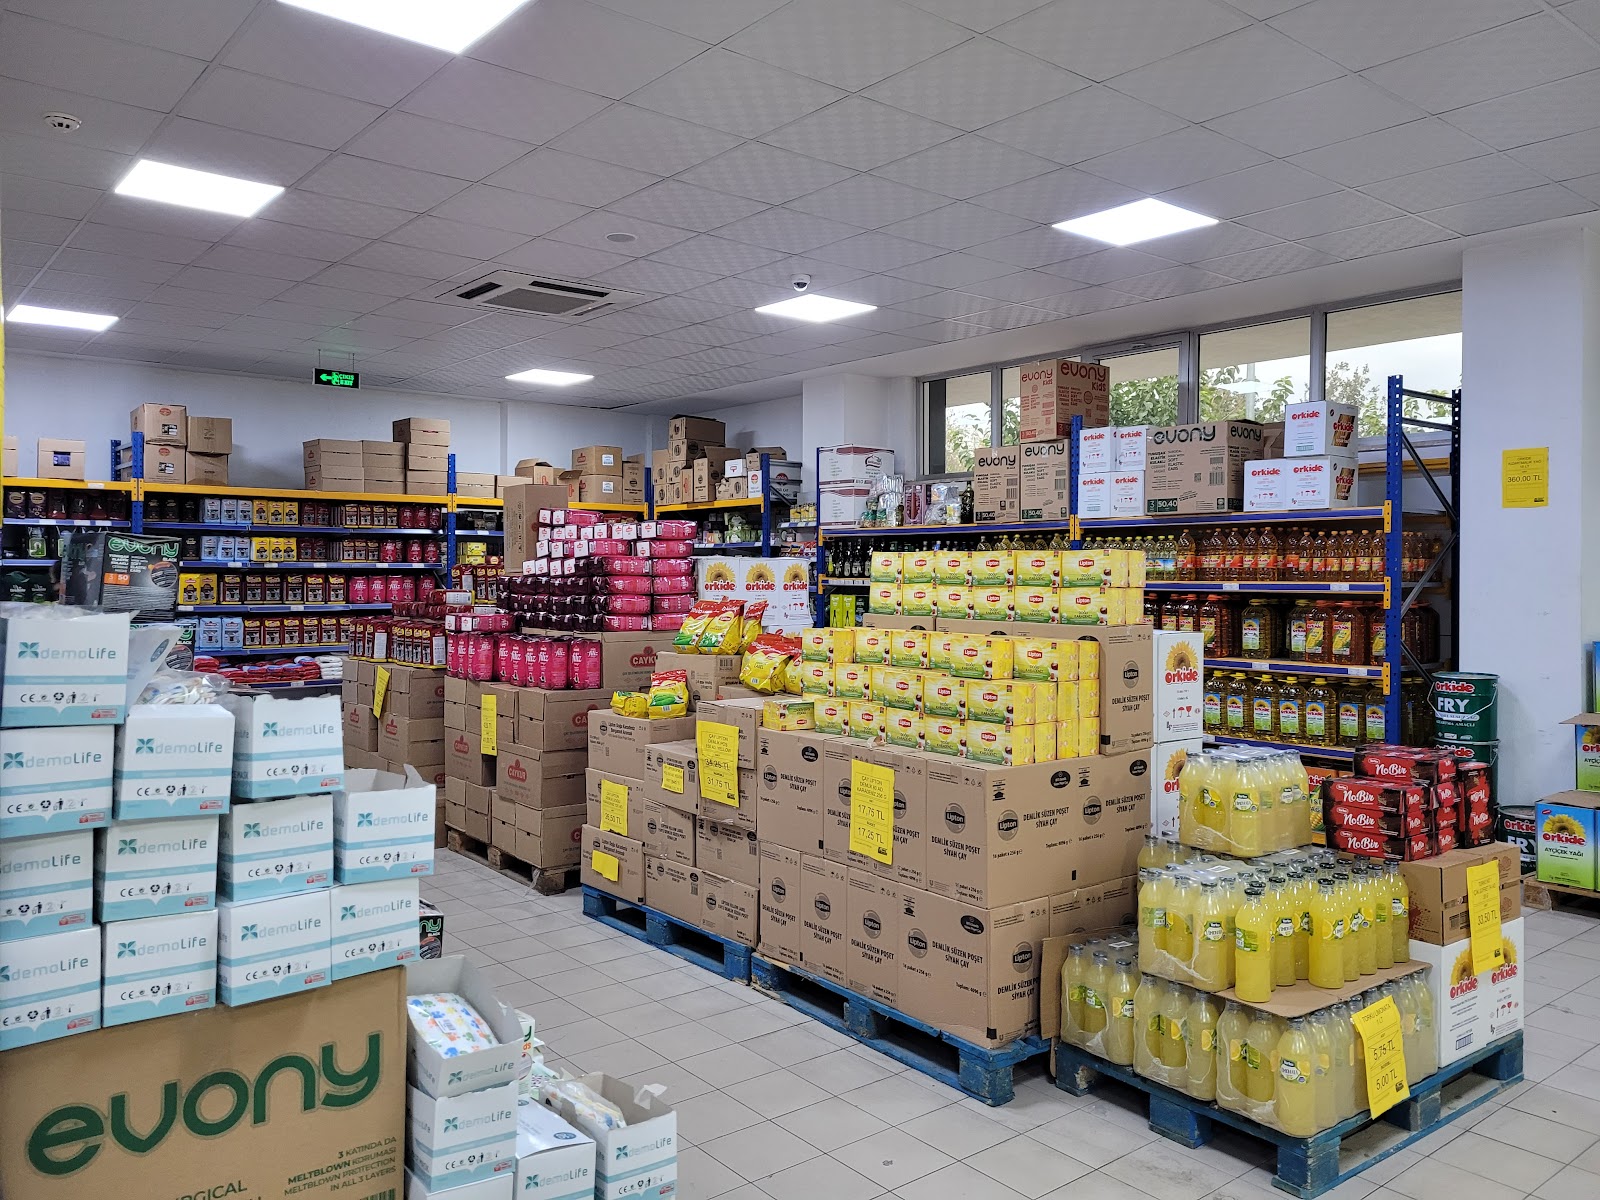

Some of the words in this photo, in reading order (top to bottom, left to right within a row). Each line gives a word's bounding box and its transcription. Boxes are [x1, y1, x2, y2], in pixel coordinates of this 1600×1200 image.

[1022, 369, 1052, 382] evony
[1061, 362, 1106, 382] evony
[1092, 382, 1106, 391] Kids
[1291, 410, 1320, 421] orkide
[1083, 433, 1105, 441] orkide
[1120, 430, 1142, 438] orkide
[1153, 426, 1215, 444] evony
[1230, 425, 1262, 443] evony
[1025, 444, 1064, 456] evony
[978, 455, 1015, 467] evony
[1251, 467, 1281, 477] orkide
[1293, 464, 1323, 474] orkide
[1082, 477, 1105, 486] orkide
[1115, 476, 1138, 484] orkide
[704, 580, 737, 591] orkide
[745, 580, 776, 591] orkide
[782, 580, 807, 591] orkide
[1165, 667, 1199, 684] orkide
[1435, 681, 1475, 692] orkide
[1438, 697, 1470, 712] FRY
[1376, 764, 1407, 776] NoBir
[725, 782, 731, 790] TL
[1343, 790, 1374, 802] NoBir
[876, 809, 885, 820] TL
[1085, 805, 1101, 814] Lipton
[947, 813, 964, 822] Lipton
[1344, 813, 1375, 826] NoBir
[999, 821, 1016, 829] Lipton
[876, 833, 884, 844] TL
[1348, 837, 1379, 850] NoBir
[1543, 833, 1586, 846] orkide
[816, 902, 829, 910] Lipton
[1491, 910, 1498, 920] TL
[865, 919, 880, 929] Lipton
[910, 938, 926, 948] Lipton
[1014, 953, 1031, 962] Lipton
[1491, 963, 1518, 984] orkide
[1449, 975, 1479, 999] orkide
[1387, 1040, 1395, 1052] TL
[1376, 1073, 1389, 1091] 5,00
[1390, 1069, 1398, 1080] TL
[27, 1032, 382, 1176] evony
[337, 1151, 344, 1159] 3
[345, 1140, 383, 1156] KATINDA
[384, 1136, 397, 1145] DA
[288, 1159, 351, 1185] MELTBLOWN
[352, 1147, 397, 1166] KORUMASI
[284, 1173, 341, 1196] MELTBLOWN
[343, 1156, 396, 1177] PROTECTION
[331, 1183, 340, 1192] IN
[341, 1177, 358, 1189] ALL
[358, 1174, 365, 1184] 3
[365, 1166, 397, 1181] LAYERS
